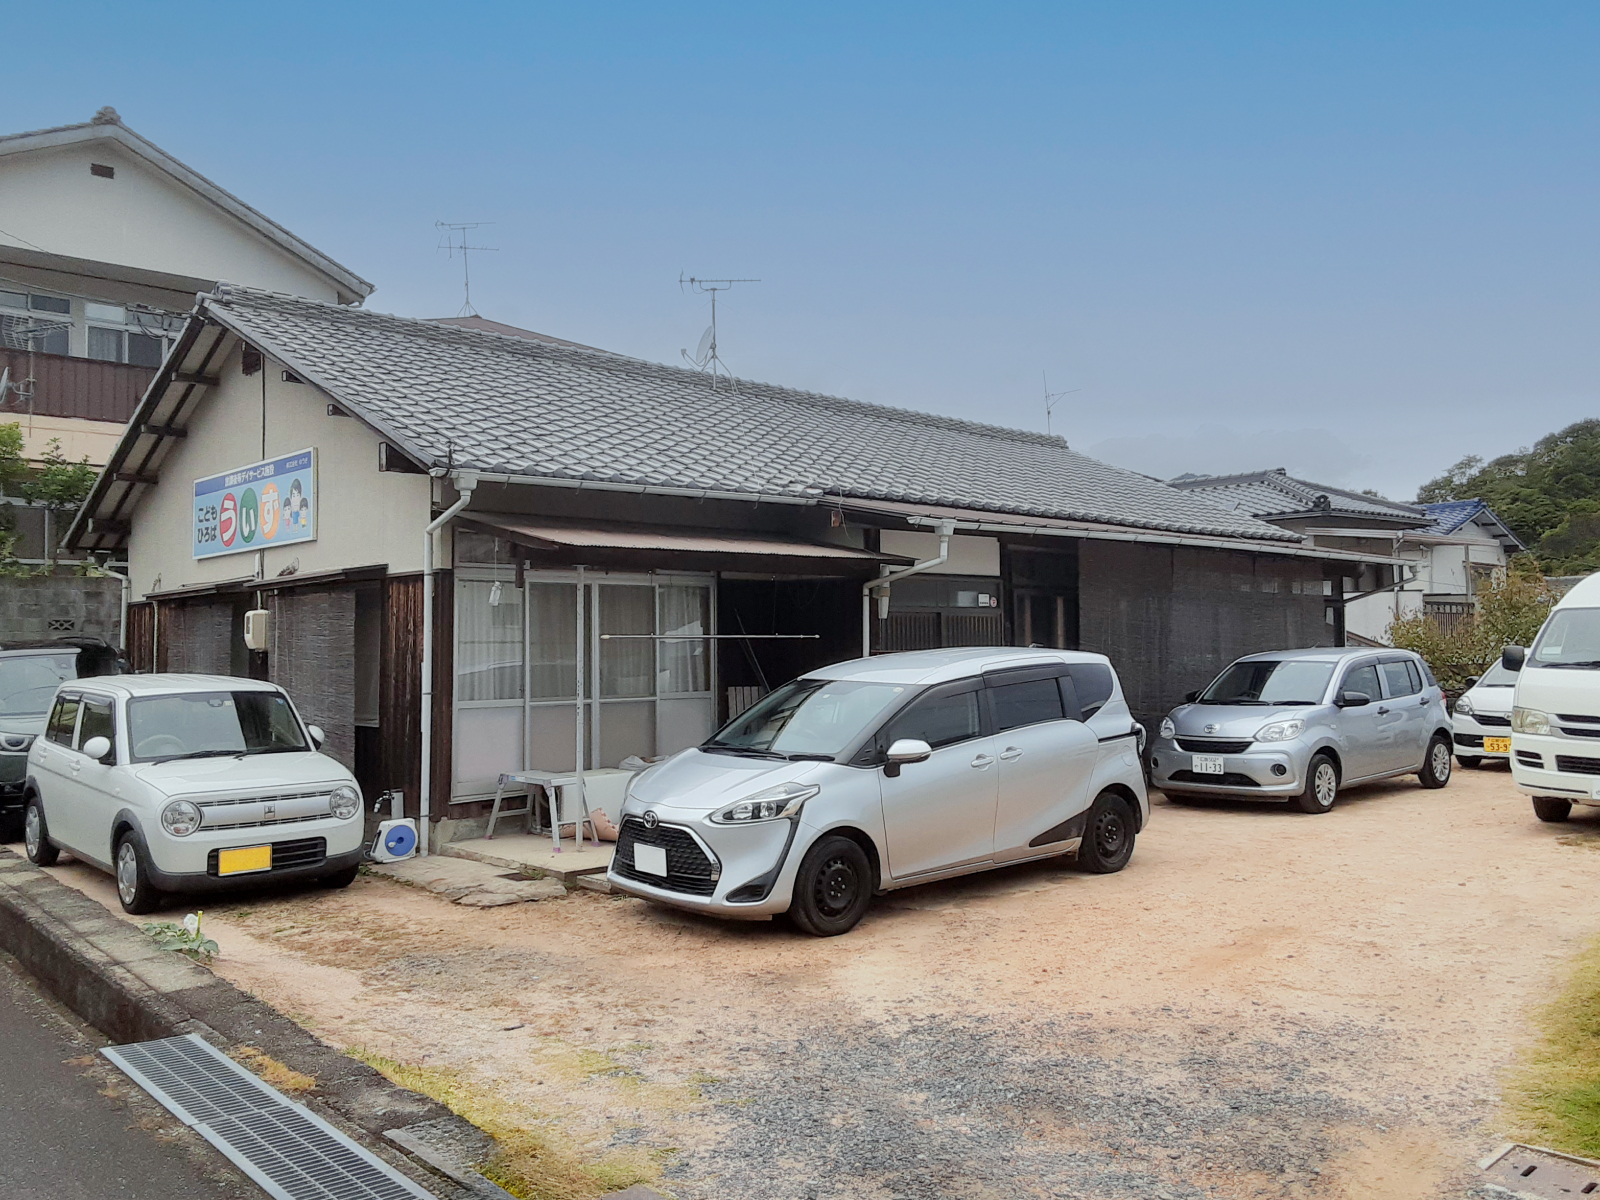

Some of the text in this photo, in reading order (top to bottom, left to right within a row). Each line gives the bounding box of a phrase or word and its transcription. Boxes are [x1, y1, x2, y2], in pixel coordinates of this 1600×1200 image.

[198, 505, 218, 523] こども
[221, 490, 279, 542] ういず
[197, 525, 218, 544] ひろば
